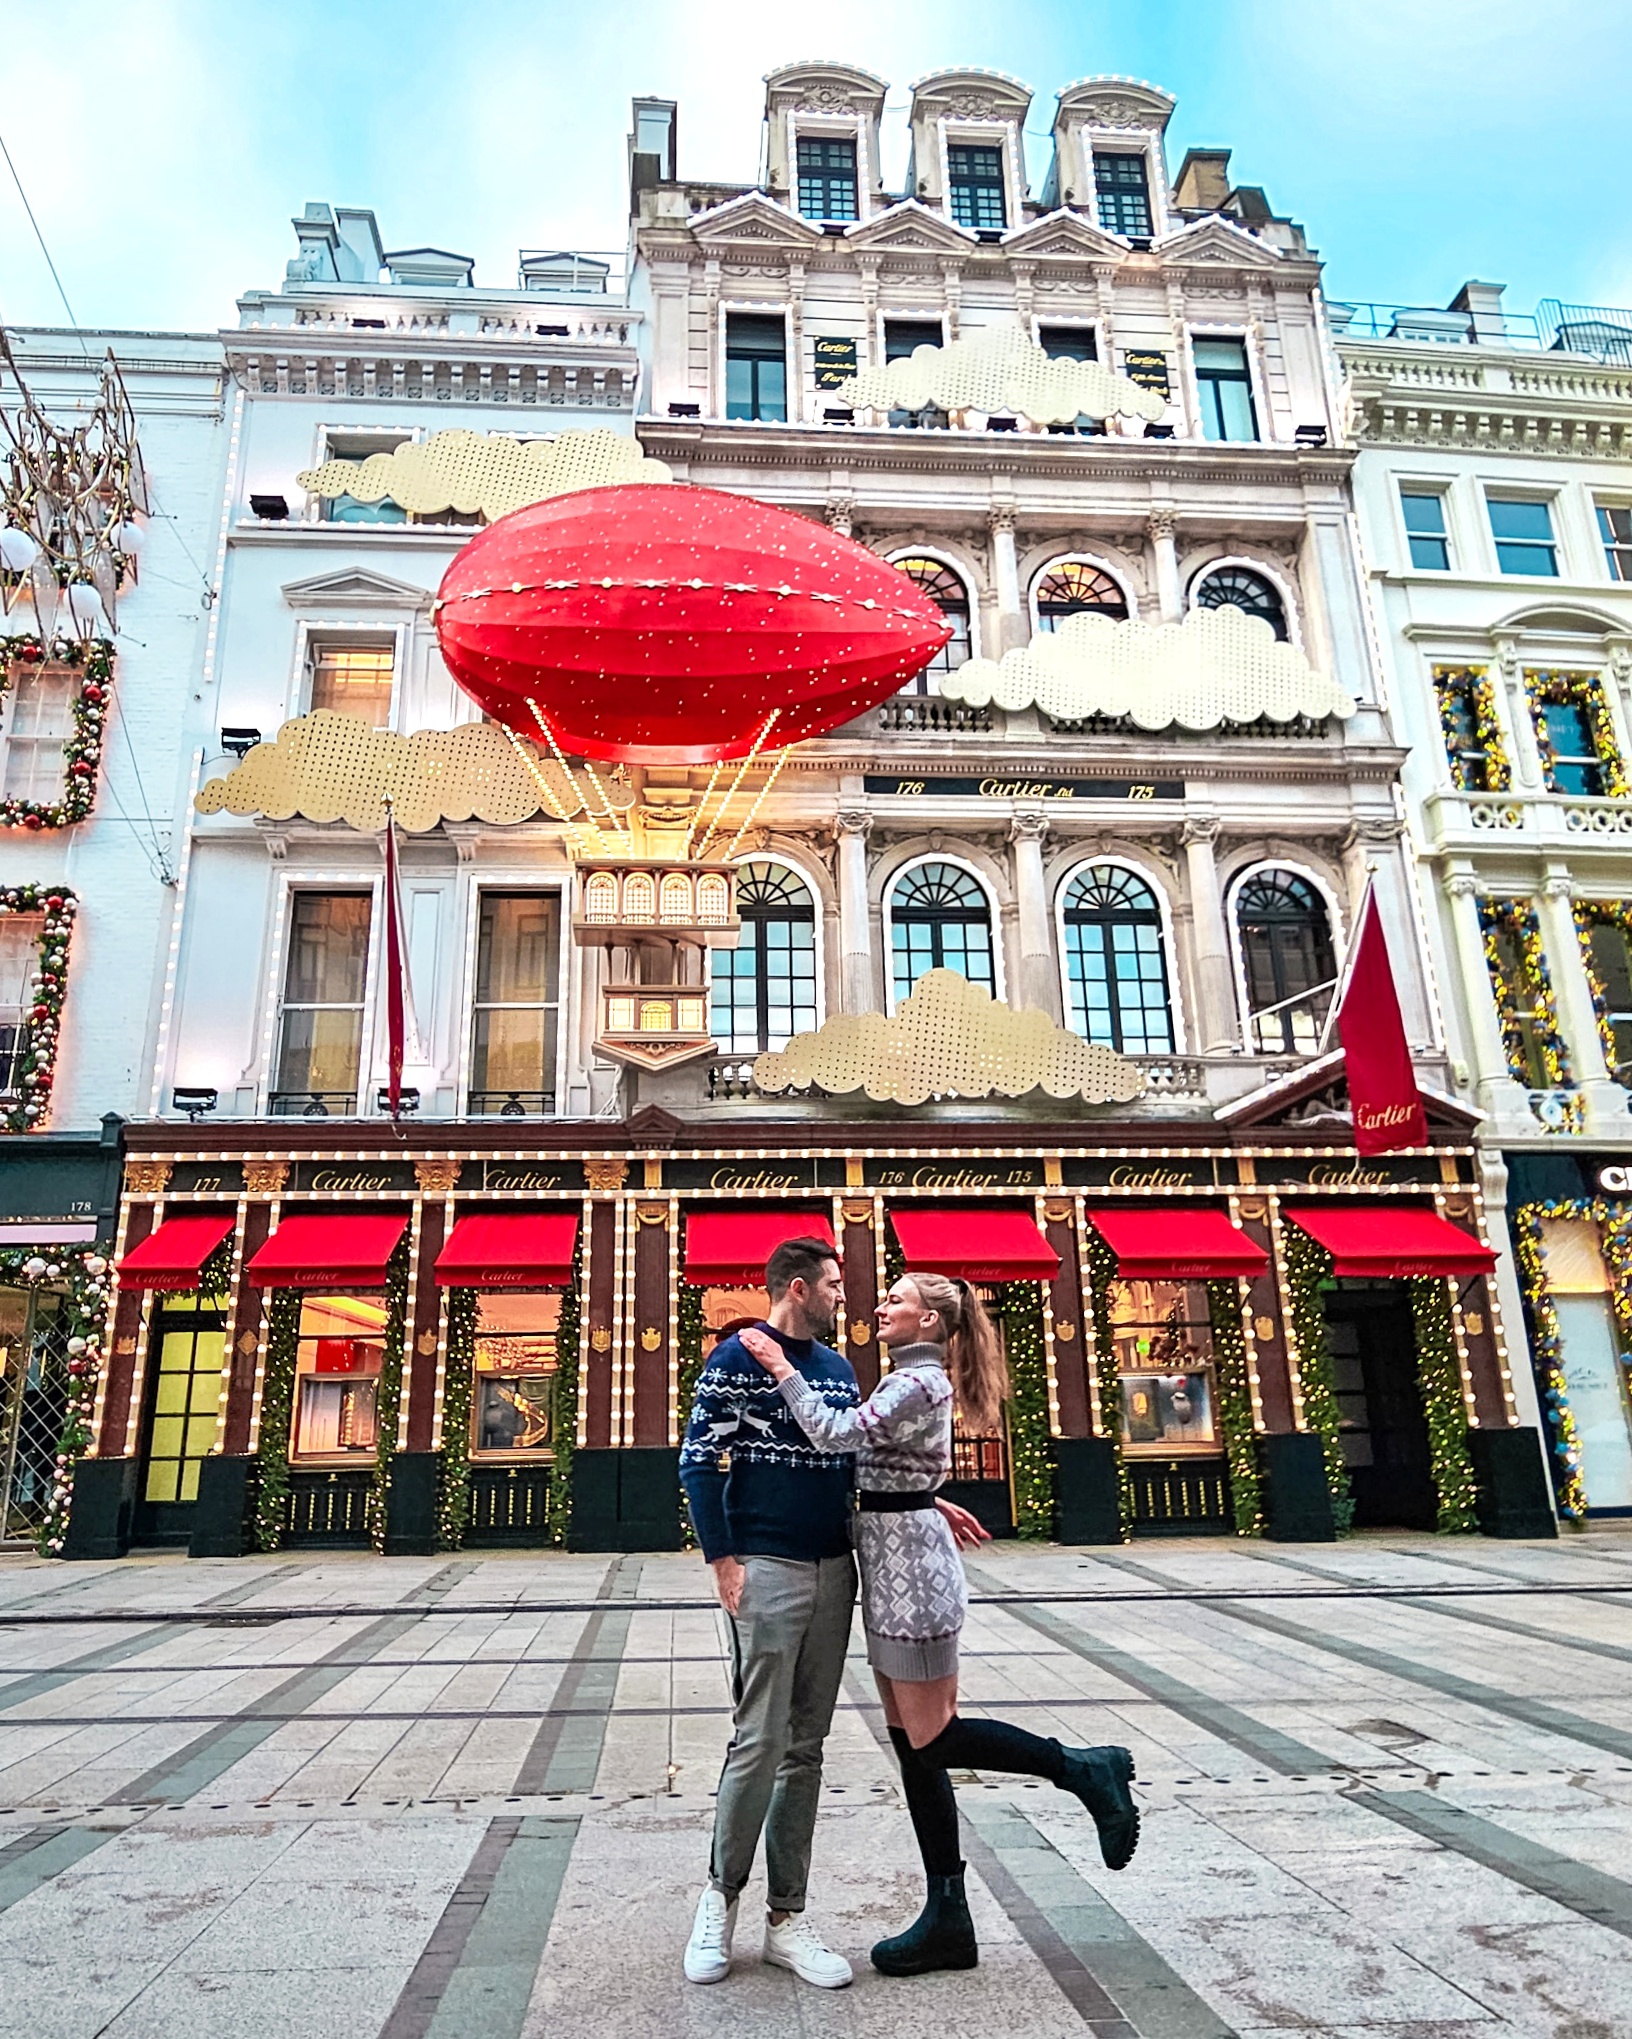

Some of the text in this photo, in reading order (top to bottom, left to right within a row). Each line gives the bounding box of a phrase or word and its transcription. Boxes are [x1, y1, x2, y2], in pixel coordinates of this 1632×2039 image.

[817, 342, 854, 353] Cartier
[1126, 354, 1166, 365] Cartier
[896, 781, 925, 795] 176
[978, 778, 1052, 797] Cartier
[1128, 785, 1155, 798] 175
[1357, 1103, 1417, 1131] Cartier
[311, 1170, 392, 1191] Cartier
[484, 1169, 561, 1190] Cartier
[710, 1167, 799, 1189] Cartier
[878, 1166, 1033, 1187] 176 Cartier 175
[1109, 1165, 1193, 1187] Cartier
[1308, 1164, 1391, 1185] Cartier
[1600, 1166, 1632, 1191] C
[193, 1178, 221, 1191] 177
[70, 1202, 92, 1212] 178
[294, 1270, 339, 1281] Cartier
[481, 1269, 525, 1281] Cartier
[960, 1264, 1002, 1276] Cartier
[1171, 1262, 1212, 1273] Cartier
[135, 1271, 182, 1283] Cartier
